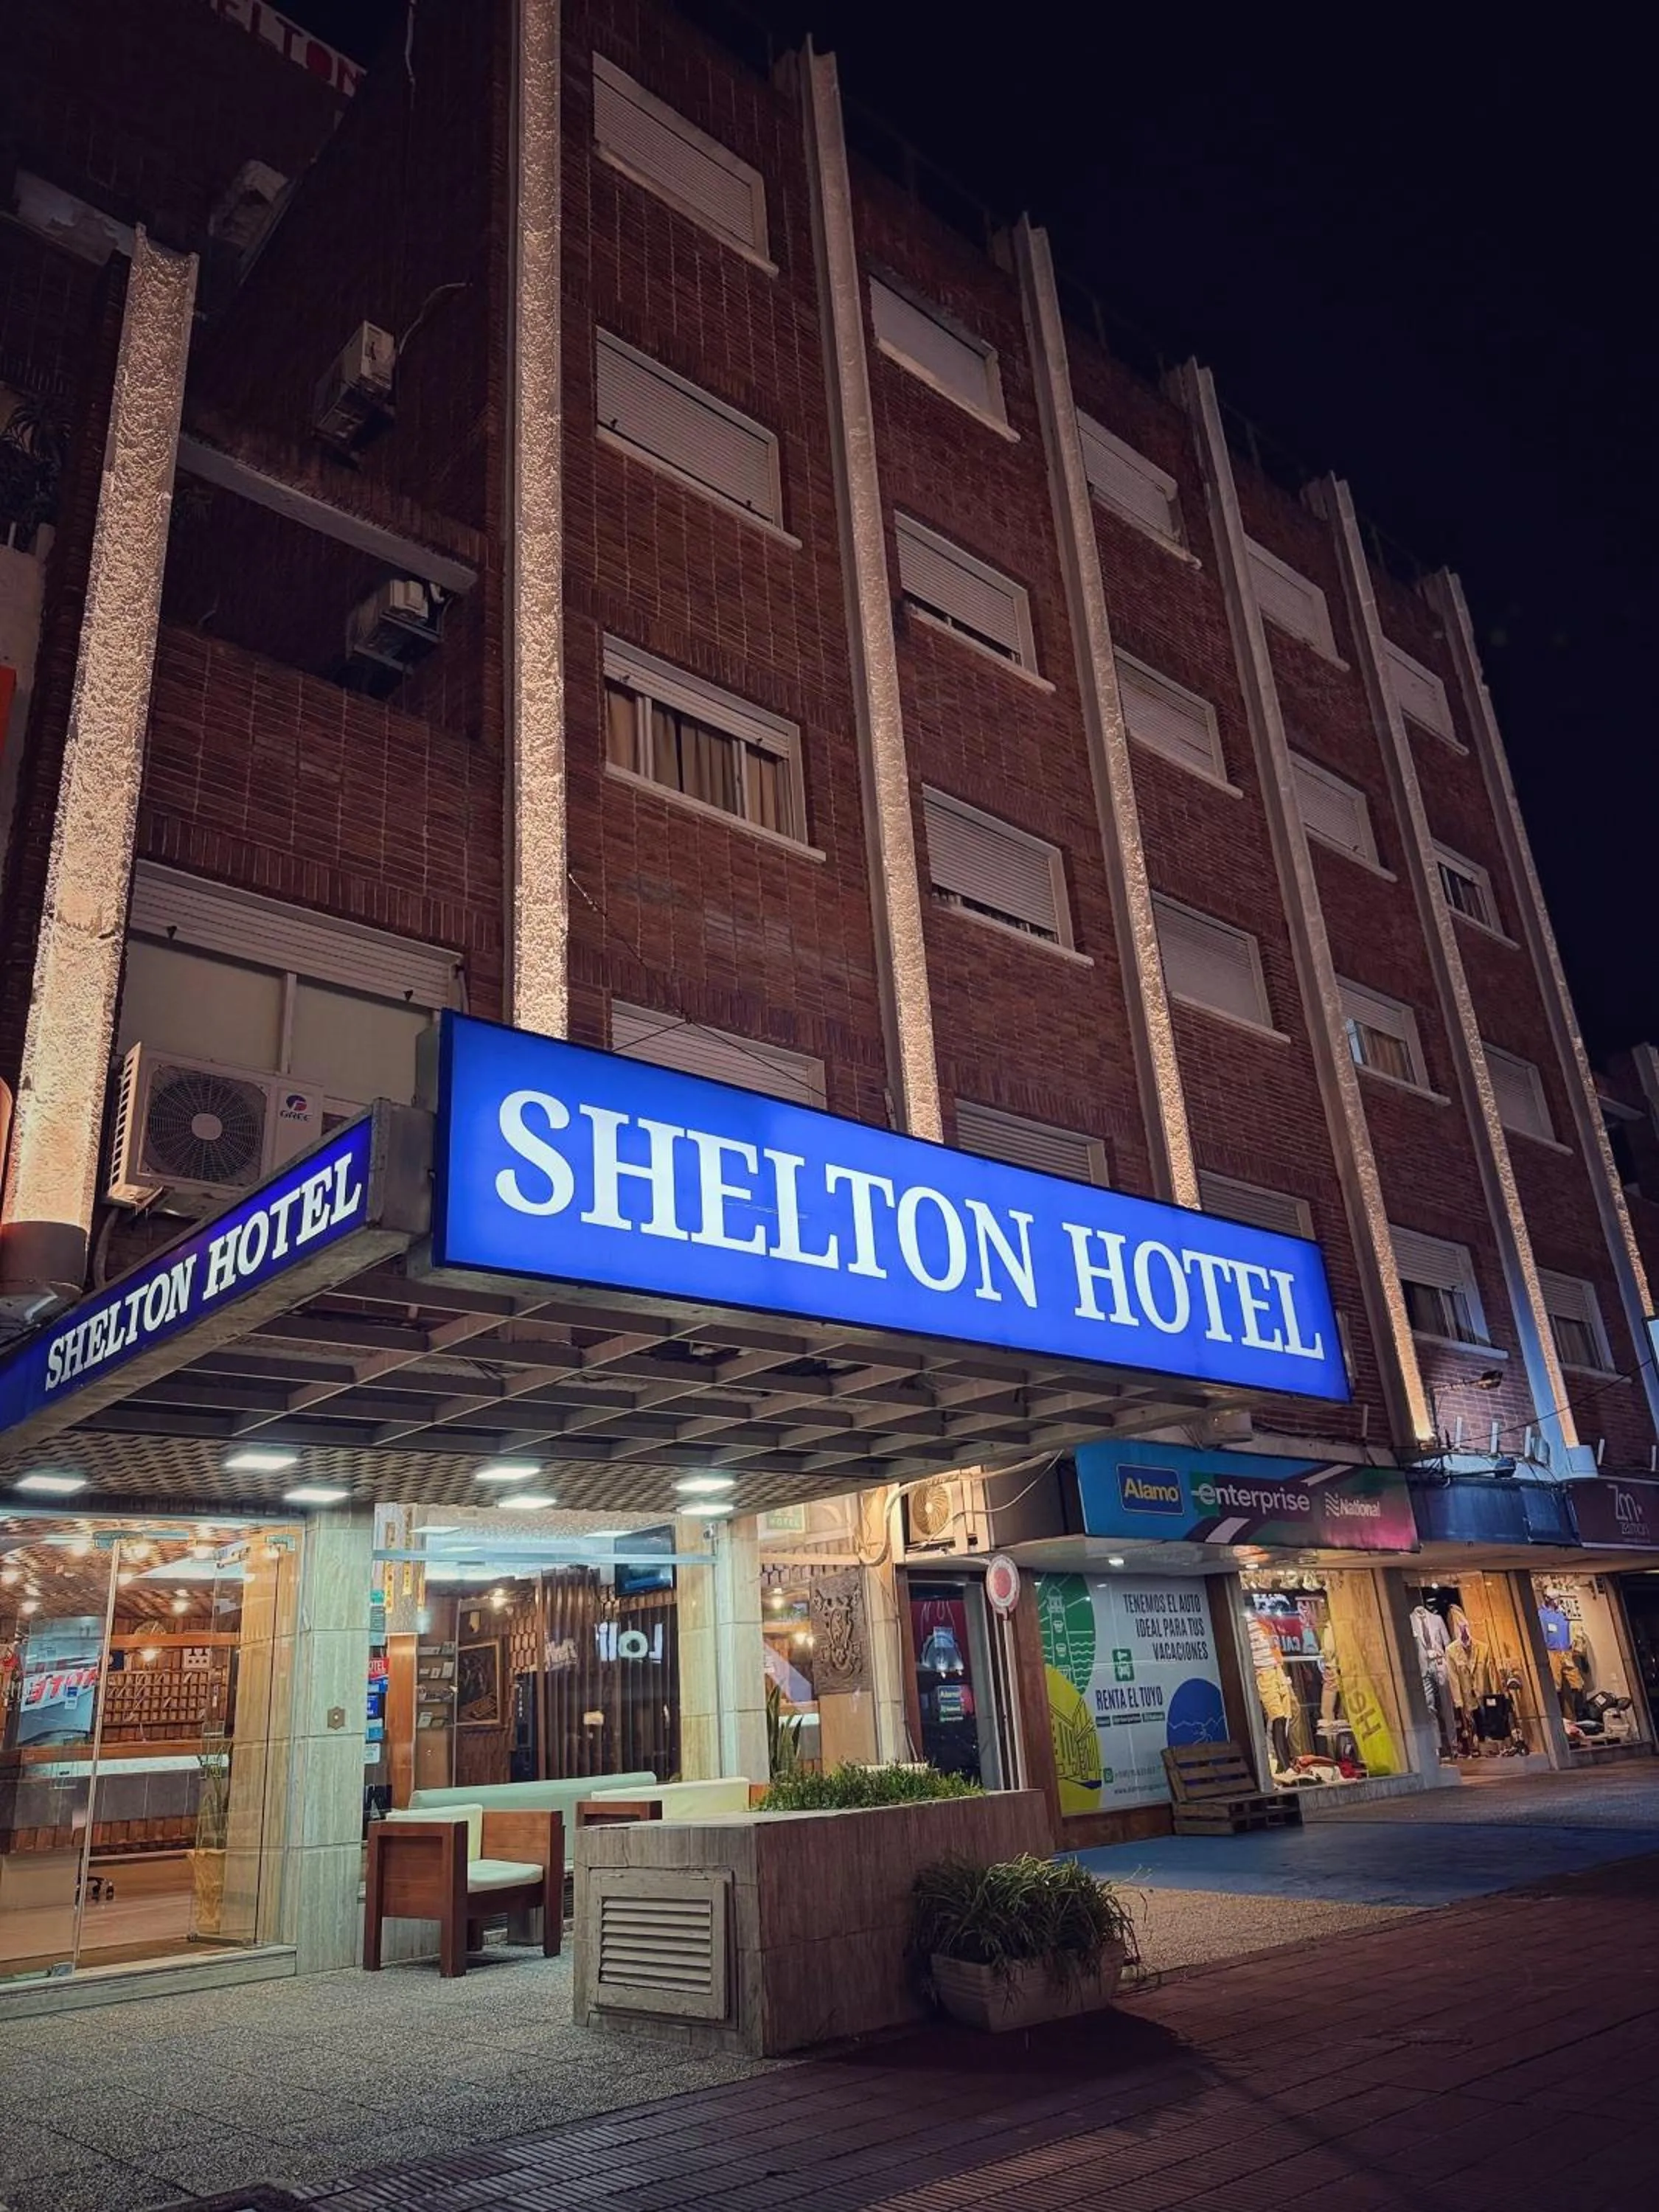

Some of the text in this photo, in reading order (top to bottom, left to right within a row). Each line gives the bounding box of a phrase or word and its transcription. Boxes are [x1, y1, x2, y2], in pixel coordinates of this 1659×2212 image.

[495, 1091, 1324, 1359] SHELTON HOTEL
[46, 1152, 361, 1391] SHELTON HOTEL
[1124, 1478, 1179, 1502] Alamo
[1192, 1483, 1310, 1514] enterprise
[1340, 1498, 1381, 1517] National
[1123, 1593, 1201, 1613] TENEMOS EL AUTO
[1135, 1618, 1205, 1638] IDEAL PARA TUS
[1152, 1641, 1208, 1661] VACACIONES
[1096, 1686, 1163, 1711] RENTA EL TUYO
